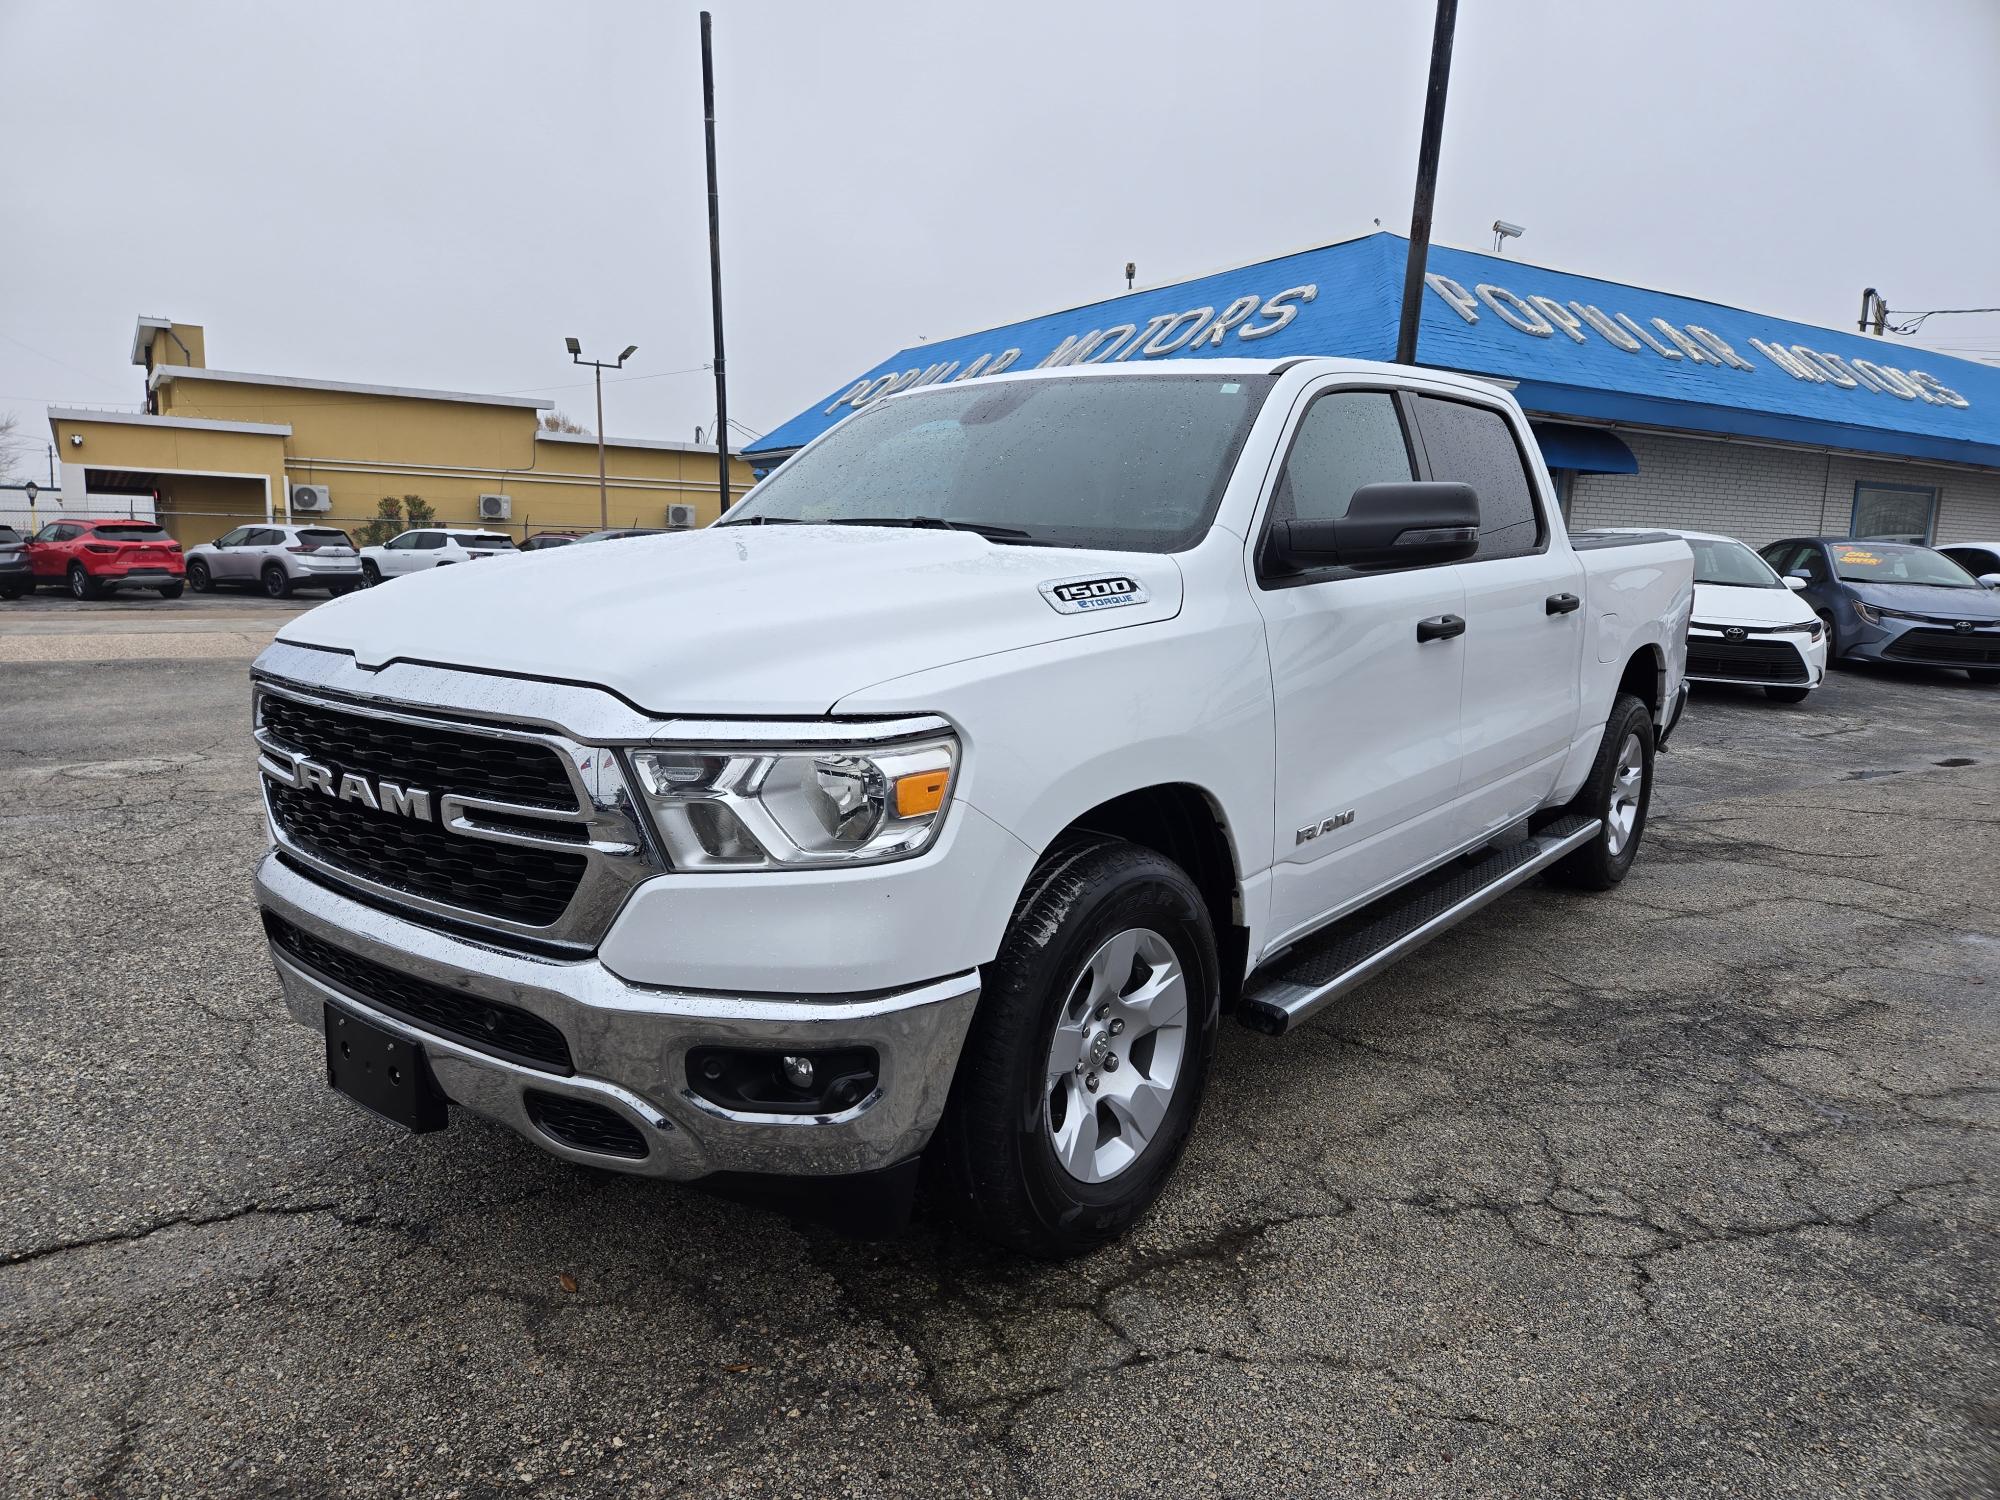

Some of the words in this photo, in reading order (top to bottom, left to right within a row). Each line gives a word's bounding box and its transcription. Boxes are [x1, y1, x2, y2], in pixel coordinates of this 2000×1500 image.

[824, 347, 1023, 416] POPULAR
[1035, 283, 1319, 369] MOTORS
[1425, 272, 1756, 372] POPULAR
[1748, 337, 1970, 410] MOTORS
[1057, 580, 1131, 601] 1500
[298, 757, 433, 822] RAM
[1296, 808, 1355, 846] RAM
